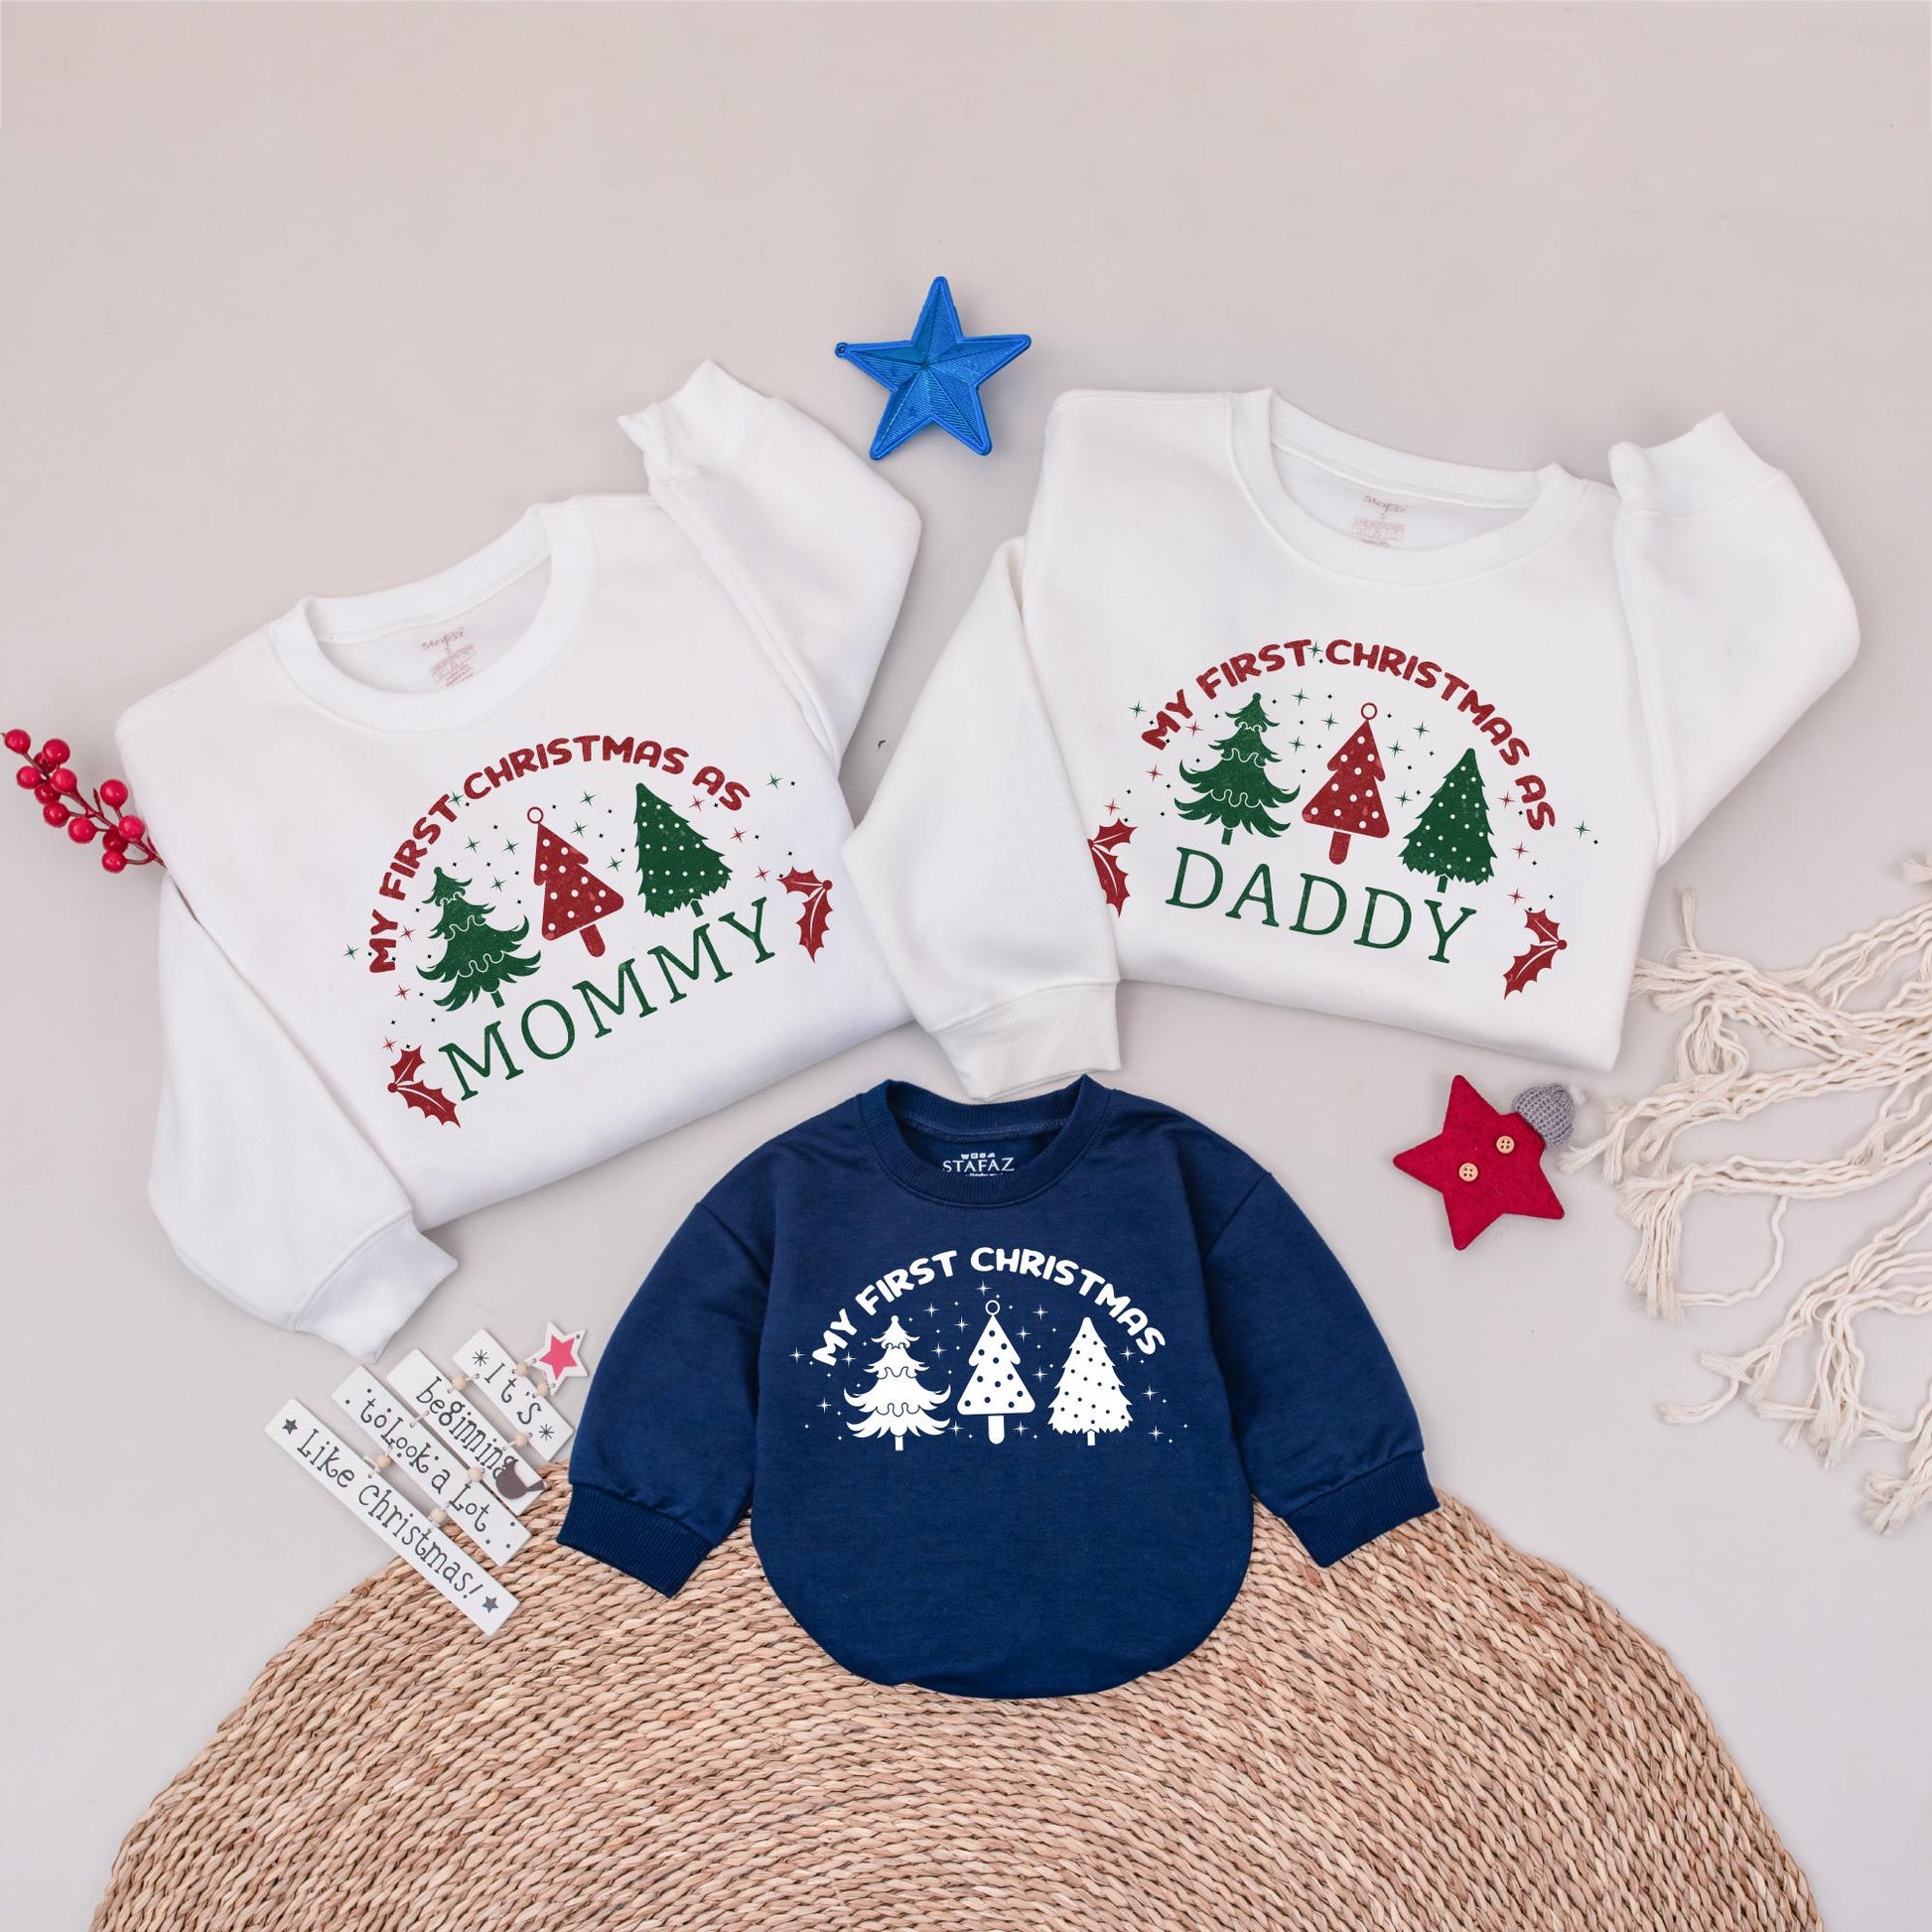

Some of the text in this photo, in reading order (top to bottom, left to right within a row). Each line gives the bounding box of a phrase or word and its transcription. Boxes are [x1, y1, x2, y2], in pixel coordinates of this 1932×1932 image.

[1141, 638, 1556, 831] MY FIRST CHRISTMAS AS
[368, 734, 751, 974] MY FIRST CHRISTMAS AS
[1165, 846, 1477, 964] DADDY
[438, 897, 775, 1101] MOMMY
[942, 1158, 1015, 1173] STAFAZ
[811, 1246, 1166, 1366] MY FIRST CHRISTMAS
[297, 1428, 354, 1487] Like
[431, 1469, 450, 1494] a
